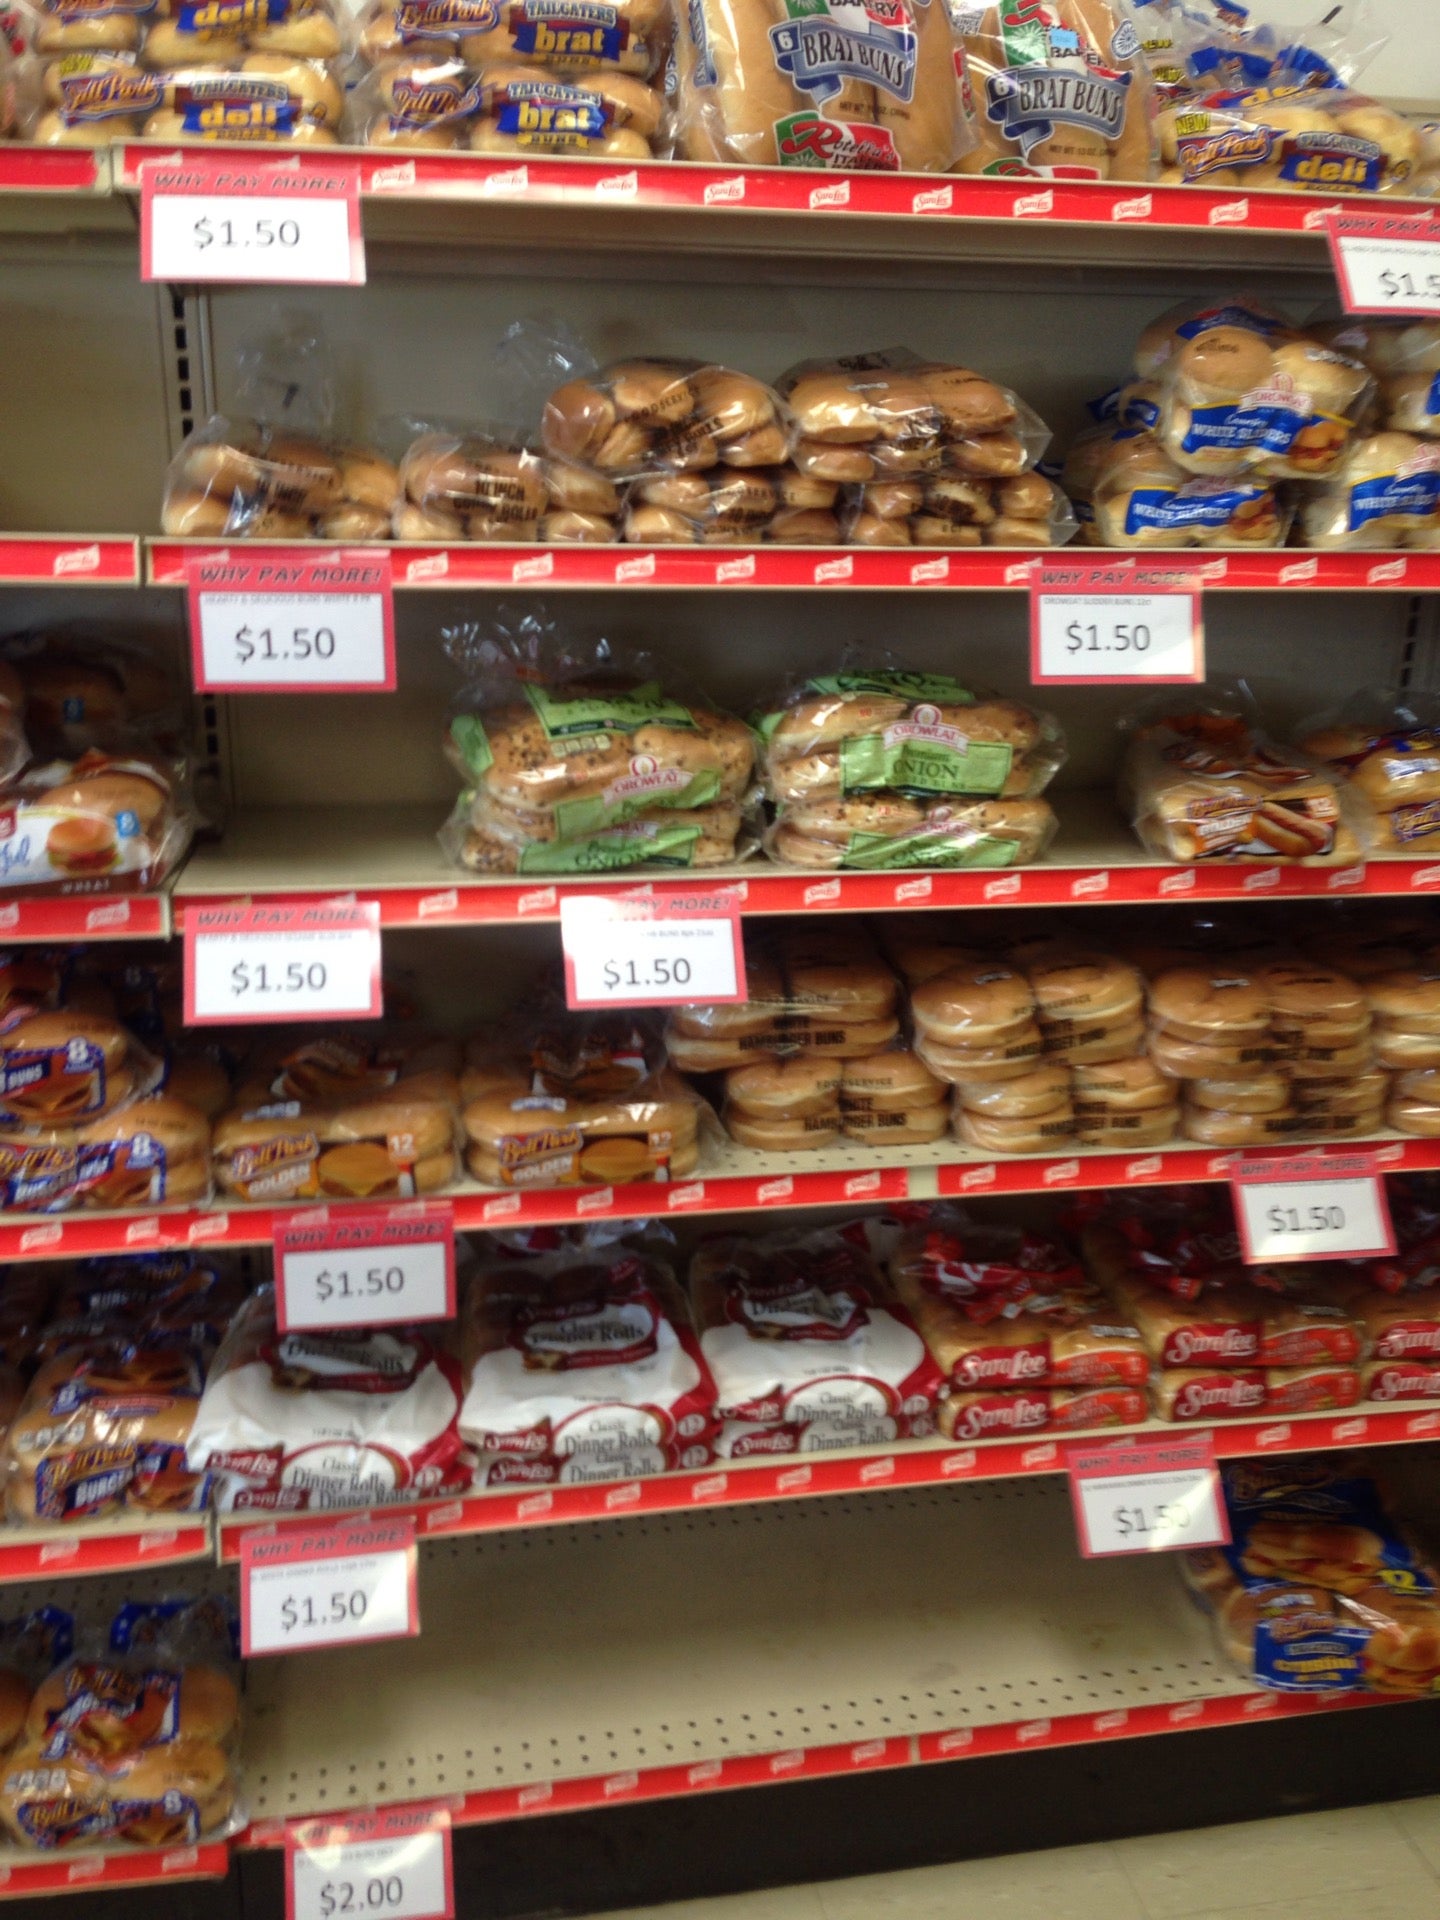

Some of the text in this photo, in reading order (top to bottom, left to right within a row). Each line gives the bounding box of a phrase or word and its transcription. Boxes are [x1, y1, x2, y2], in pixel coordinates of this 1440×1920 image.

[527, 1, 617, 28] TAILGATERS
[535, 22, 605, 53] brat
[777, 31, 793, 50] 6
[803, 31, 905, 87] BRAT BUNS
[1019, 77, 1122, 123] BRAT BUNS
[200, 101, 278, 127] deli
[518, 102, 591, 133] brat
[154, 173, 346, 191] WHY PAY MORE!
[1296, 155, 1368, 184] deli
[193, 215, 301, 250] $1.50
[1379, 268, 1440, 299] $1.5
[200, 565, 382, 584] WHY PAY MORE!
[1041, 571, 1084, 586] WHY
[1090, 571, 1129, 586] PAY
[235, 624, 336, 664] $1.50
[1066, 620, 1151, 655] $1.50
[614, 772, 679, 795] OROWEAT
[892, 759, 961, 781] ONION
[670, 896, 732, 911] MORE!
[197, 911, 246, 926] WHY
[251, 909, 295, 924] PAY
[231, 958, 327, 997] $1.50
[603, 957, 691, 991] $1.50
[68, 1037, 89, 1060] 8
[877, 1111, 908, 1128] BUNS
[390, 1133, 415, 1152] 12
[1266, 1203, 1346, 1235] $1.50
[284, 1230, 330, 1246] WHY
[335, 1227, 377, 1242] PAY
[315, 1266, 406, 1303] $1.50
[956, 1354, 1015, 1386] Sara
[1008, 1350, 1048, 1379] Lee
[795, 1404, 848, 1422] Dinner
[956, 1399, 1048, 1439] Sara Lee
[563, 1428, 653, 1456] Dinner Rolls
[808, 1427, 890, 1452] Dinner Rolls
[292, 1468, 387, 1493] Dinner Rolls
[569, 1460, 658, 1484] Dinner Rolls
[319, 1489, 373, 1509] Dinner
[252, 1528, 406, 1559] WHY PAY MORE!
[281, 1588, 368, 1633] $1.50
[320, 1874, 404, 1917] $2.00
